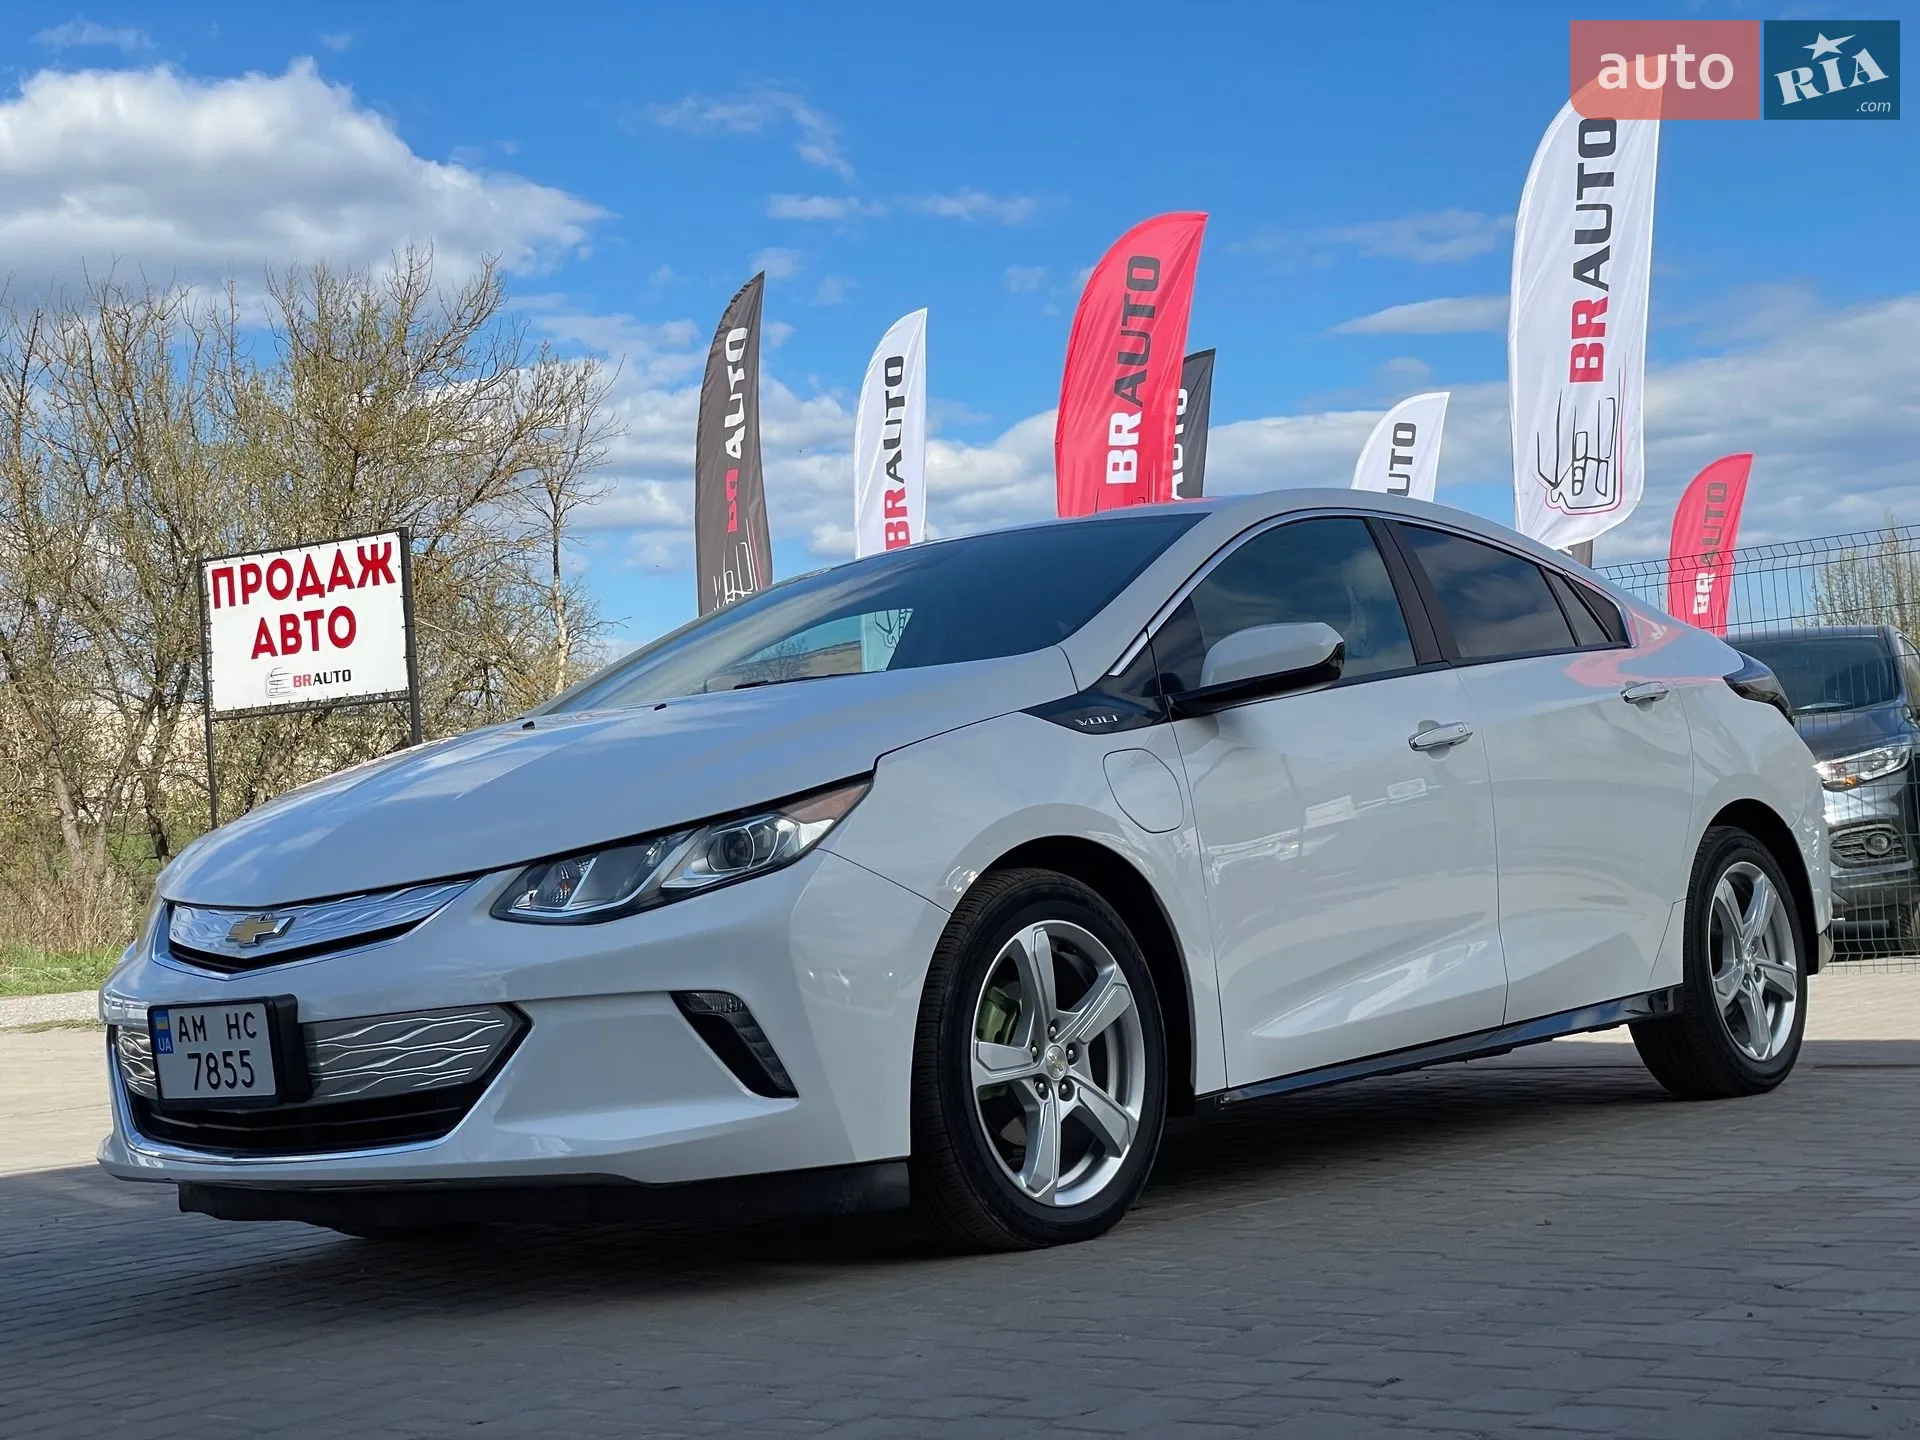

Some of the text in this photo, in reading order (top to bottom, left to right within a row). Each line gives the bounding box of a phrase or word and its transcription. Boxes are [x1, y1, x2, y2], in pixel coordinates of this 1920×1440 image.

[1568, 116, 1618, 384] BRAUTO
[1106, 255, 1161, 485] BRAUTO
[884, 355, 911, 551] BRAUTO
[211, 542, 396, 609] ПРОДАЖ
[1692, 482, 1728, 615] BRAUTO
[251, 605, 357, 659] АВТО
[292, 669, 352, 688] BRAUTO
[1075, 714, 1120, 726] VOLT
[158, 1037, 172, 1051] UA
[178, 1012, 257, 1043] AM HC
[187, 1050, 255, 1091] 7855
